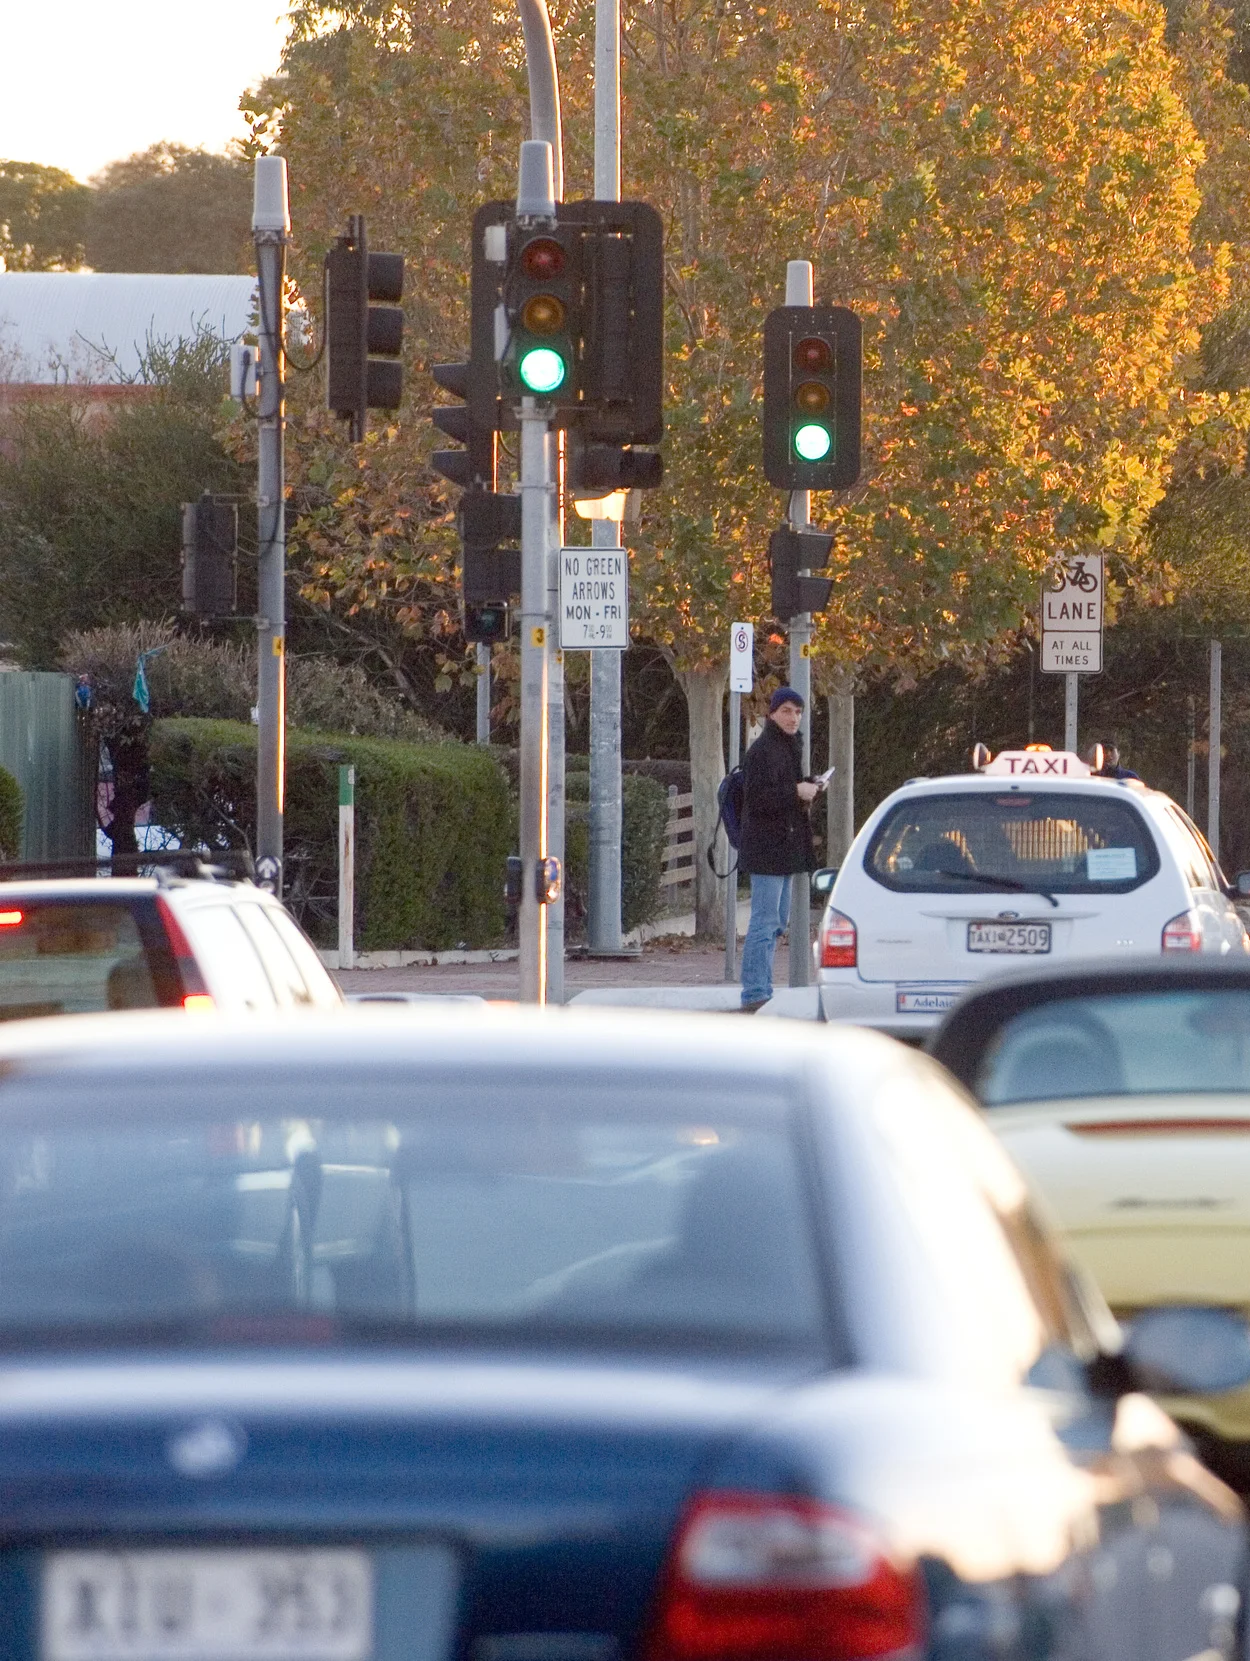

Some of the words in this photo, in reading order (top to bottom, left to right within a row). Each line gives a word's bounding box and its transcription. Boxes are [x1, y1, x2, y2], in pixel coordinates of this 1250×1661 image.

[565, 558, 580, 576] NO
[586, 558, 621, 576] GREEN
[572, 581, 615, 600] ARROWS
[566, 605, 591, 620] MON
[604, 605, 622, 619] FRI
[1048, 602, 1096, 620] LANE
[1052, 641, 1064, 650] AT
[1072, 641, 1092, 650] ALL
[1055, 655, 1089, 665] TIMES
[1005, 758, 1068, 774] TAXI
[970, 930, 997, 943] TAXI
[1007, 928, 1048, 947] 2509
